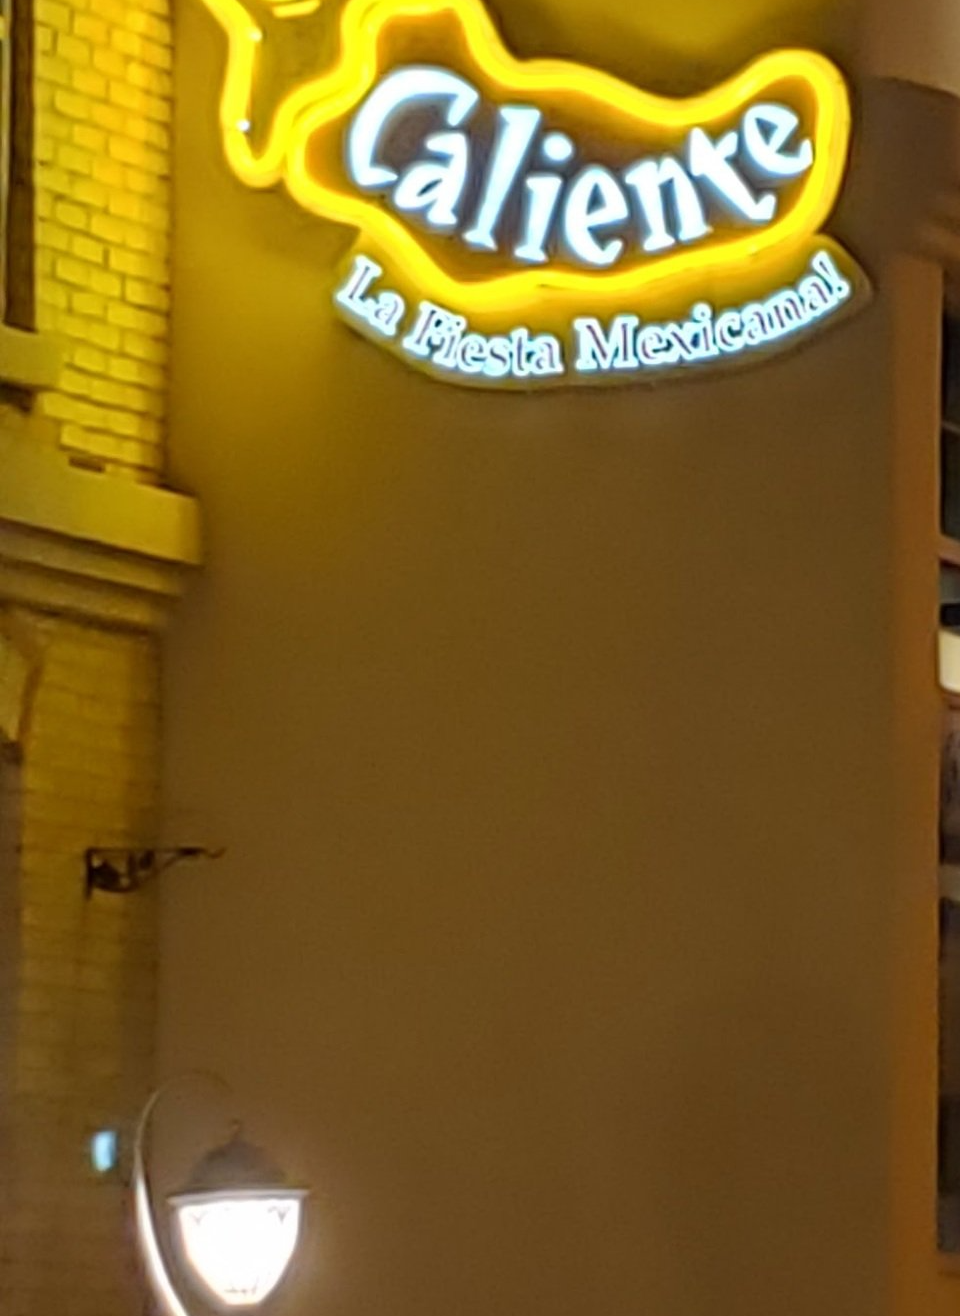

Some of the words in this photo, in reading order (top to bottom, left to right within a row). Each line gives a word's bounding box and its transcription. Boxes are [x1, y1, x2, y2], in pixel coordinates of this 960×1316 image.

[347, 65, 814, 265] Caliente
[334, 256, 404, 338] La
[404, 300, 564, 376] Fiesta
[574, 249, 851, 373] Mexicana!
